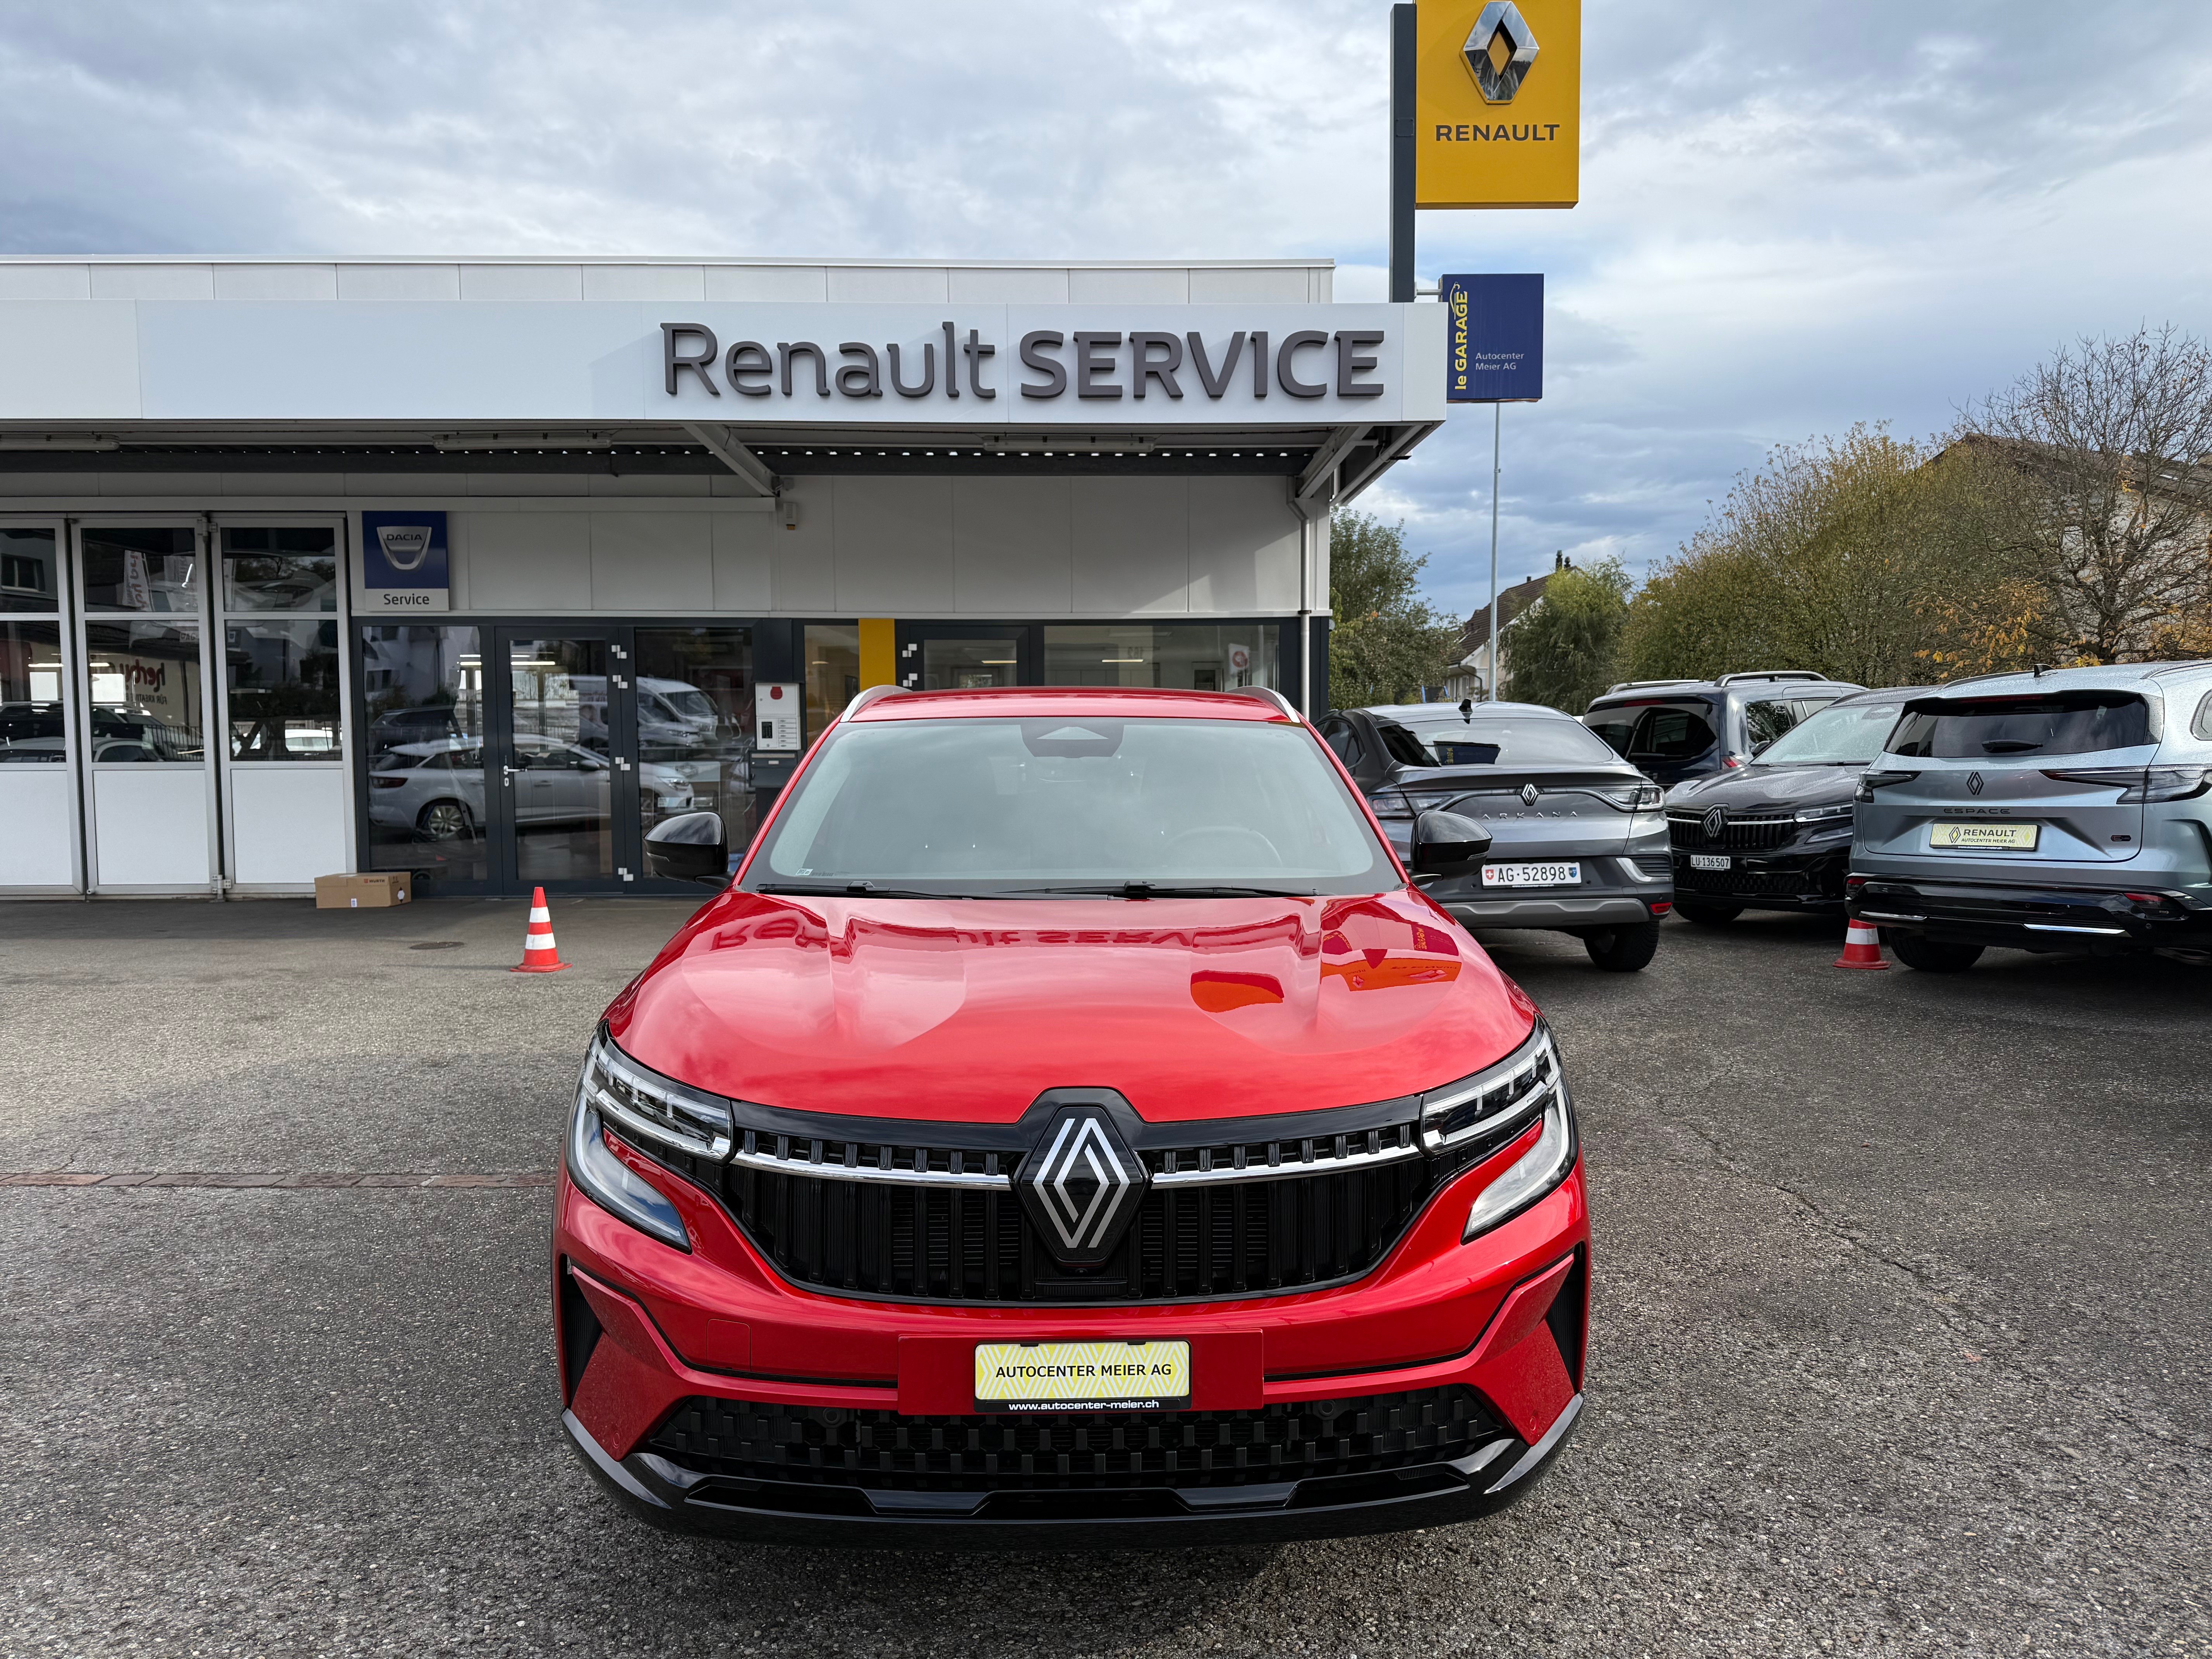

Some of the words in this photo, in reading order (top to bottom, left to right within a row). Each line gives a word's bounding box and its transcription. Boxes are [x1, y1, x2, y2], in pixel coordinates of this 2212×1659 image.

[1436, 124, 1560, 141] RENAULT
[1455, 291, 1467, 371] GARAGE
[660, 321, 996, 398] Renault
[1020, 330, 1384, 398] SERVICE
[1455, 376, 1467, 390] le
[383, 593, 429, 605] Service
[1481, 811, 1578, 820] ARKANA
[996, 1365, 1096, 1378] AUTOCENTER
[1101, 1364, 1146, 1376] MEIER
[1151, 1364, 1172, 1376] AG
[1008, 1400, 1159, 1411] www.autocenter-meier.ch
